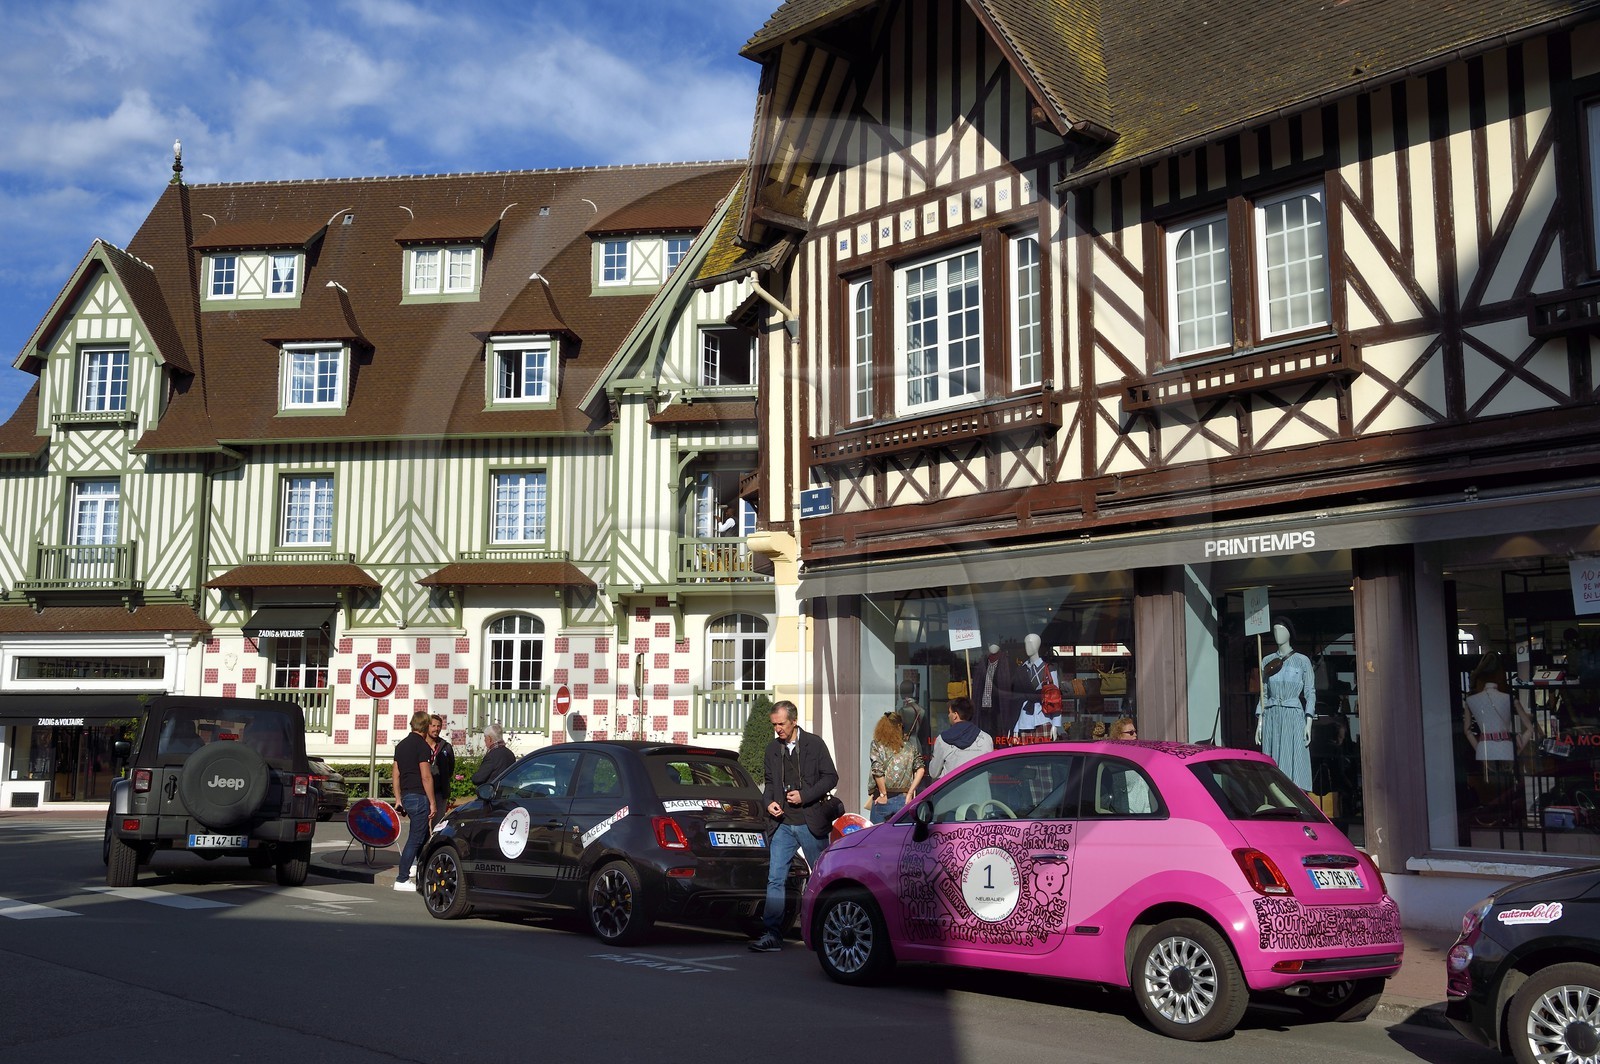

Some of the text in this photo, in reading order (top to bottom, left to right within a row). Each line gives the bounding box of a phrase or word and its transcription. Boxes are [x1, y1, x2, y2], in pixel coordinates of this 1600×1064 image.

[1204, 530, 1316, 558] PRINTEMPS
[207, 775, 245, 791] Jeep
[509, 819, 519, 836] 9
[475, 863, 506, 873] ABARTH
[963, 848, 1019, 886] PARIS DEAUVILLE 2018
[984, 864, 995, 889] 1
